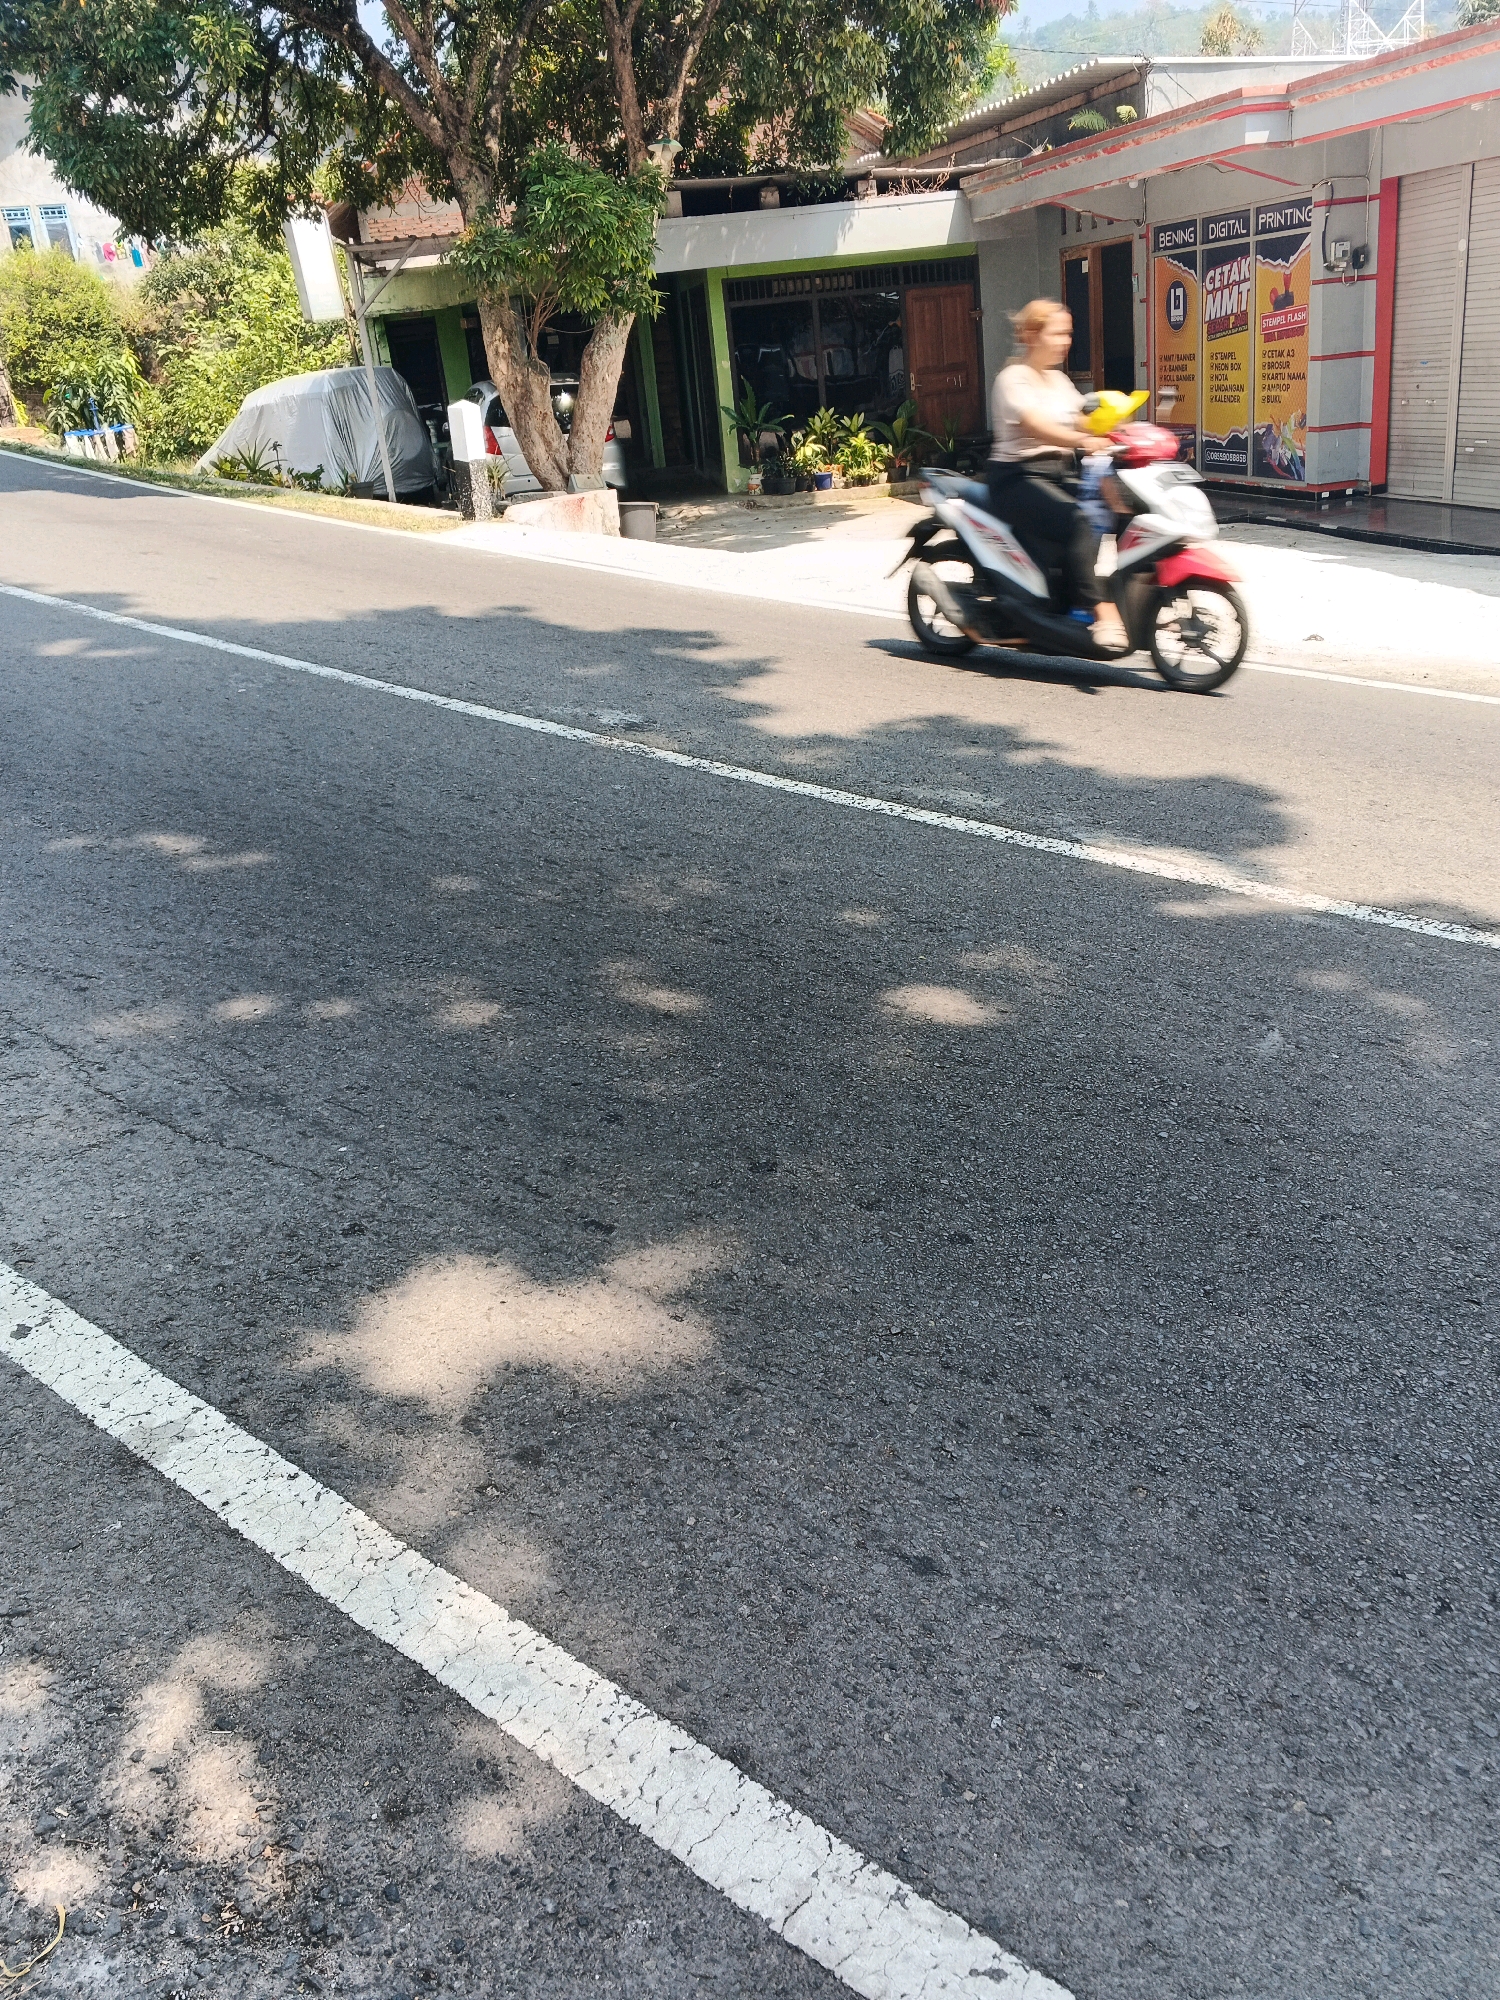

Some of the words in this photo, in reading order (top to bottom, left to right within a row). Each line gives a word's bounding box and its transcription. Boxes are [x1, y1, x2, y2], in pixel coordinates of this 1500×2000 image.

[1159, 227, 1194, 248] BENING
[1208, 219, 1247, 240] DIGITAL
[1258, 205, 1312, 231] PRINTING
[1205, 256, 1250, 292] CETAK
[1204, 281, 1250, 322] MMT
[1262, 315, 1286, 328] STEMPEL
[1287, 311, 1306, 323] FLASH
[1214, 351, 1237, 361] STEMPEL
[1267, 349, 1286, 359] CETAK
[1286, 348, 1295, 358] A3
[1214, 362, 1229, 371] NEON
[1230, 362, 1242, 371] BOX
[1267, 360, 1291, 370] BROSUR
[1175, 373, 1196, 382] BANNER
[1214, 373, 1229, 382] NOTA
[1266, 372, 1286, 381] KARTU
[1287, 371, 1306, 381] NAMA
[1214, 383, 1245, 393] UNDANGAN
[1266, 383, 1291, 392] AMPLOP
[1214, 394, 1241, 404] KALENDER
